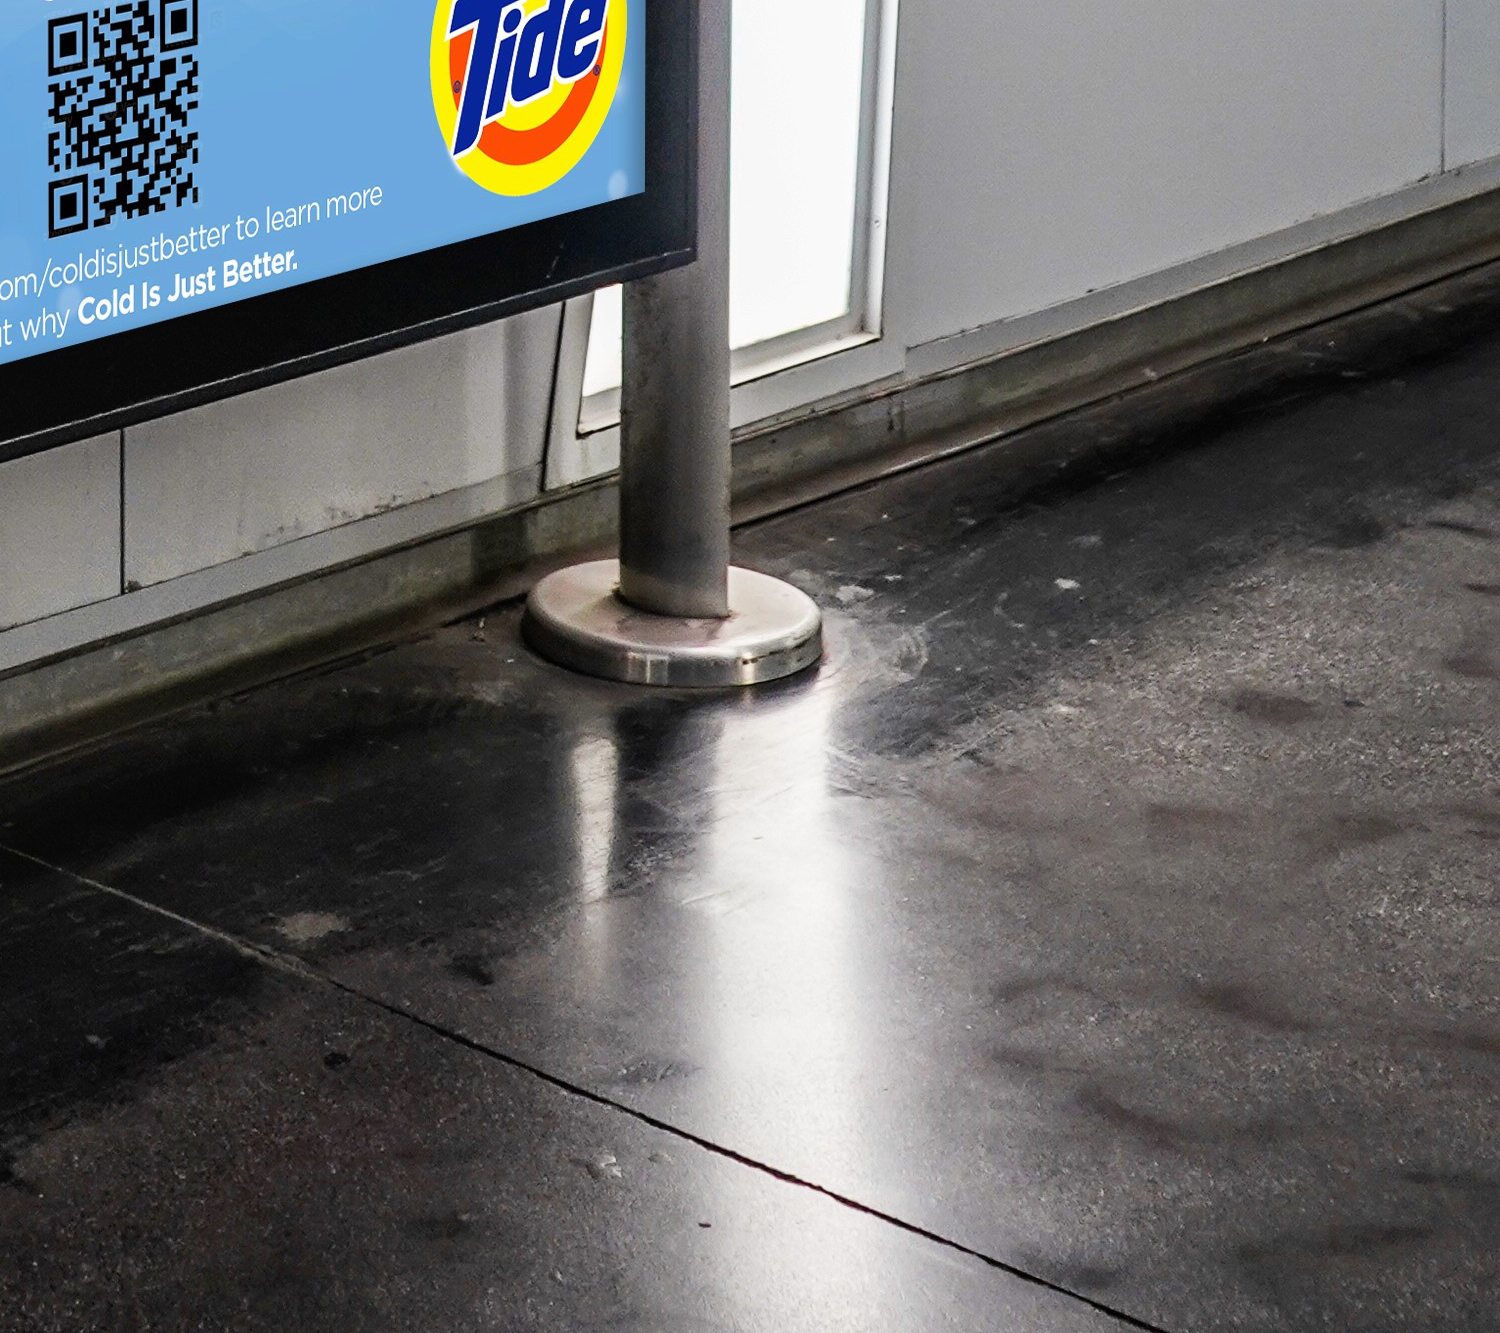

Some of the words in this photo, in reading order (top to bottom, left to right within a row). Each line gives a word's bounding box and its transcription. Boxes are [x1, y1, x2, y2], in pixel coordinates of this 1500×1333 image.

[236, 215, 260, 241] to
[266, 205, 321, 234] learn
[326, 185, 384, 220] more
[20, 307, 71, 339] why
[77, 282, 135, 326] Cold
[141, 279, 161, 310] Is
[167, 265, 217, 303] Just
[223, 249, 298, 289] Better.
